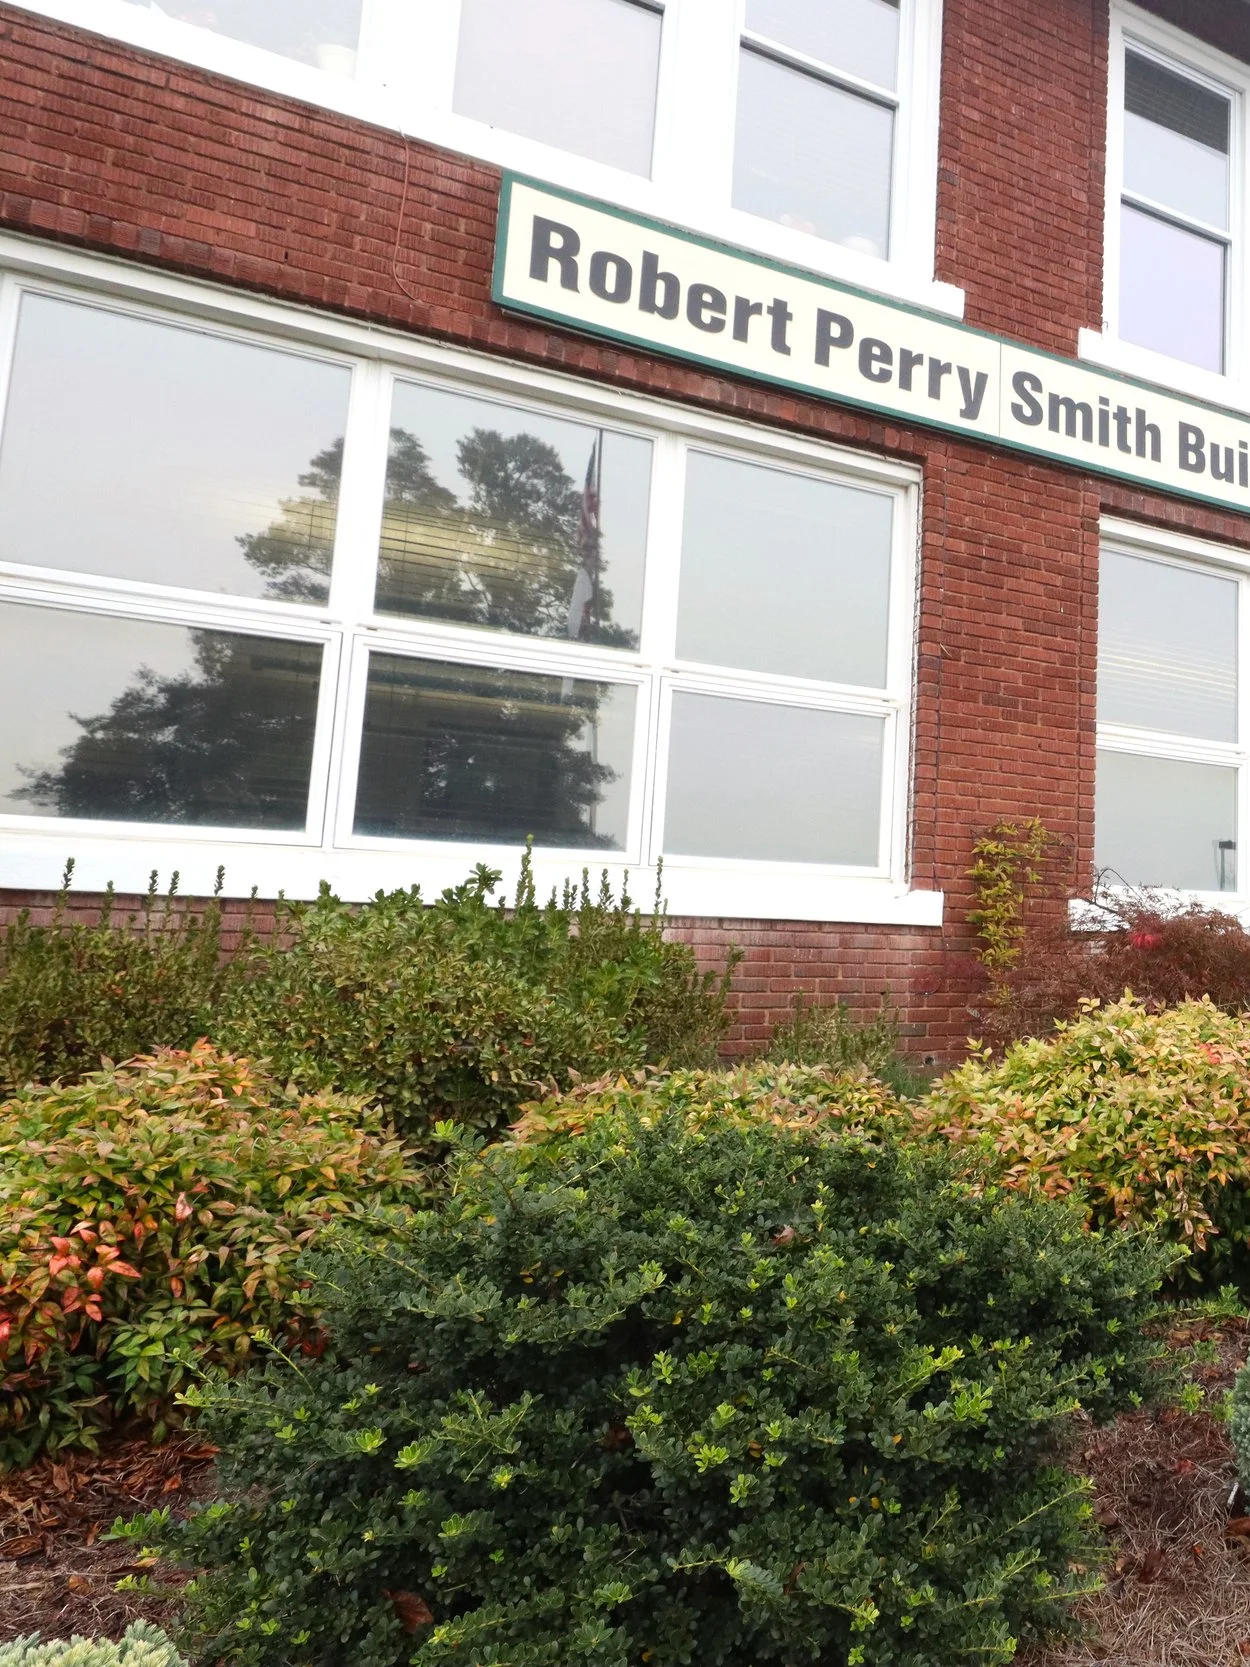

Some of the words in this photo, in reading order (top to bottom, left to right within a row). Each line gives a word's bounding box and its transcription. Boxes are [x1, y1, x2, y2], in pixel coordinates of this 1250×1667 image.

[529, 215, 793, 356] Robert
[815, 307, 989, 420] Perry
[1011, 371, 1162, 462] Smith
